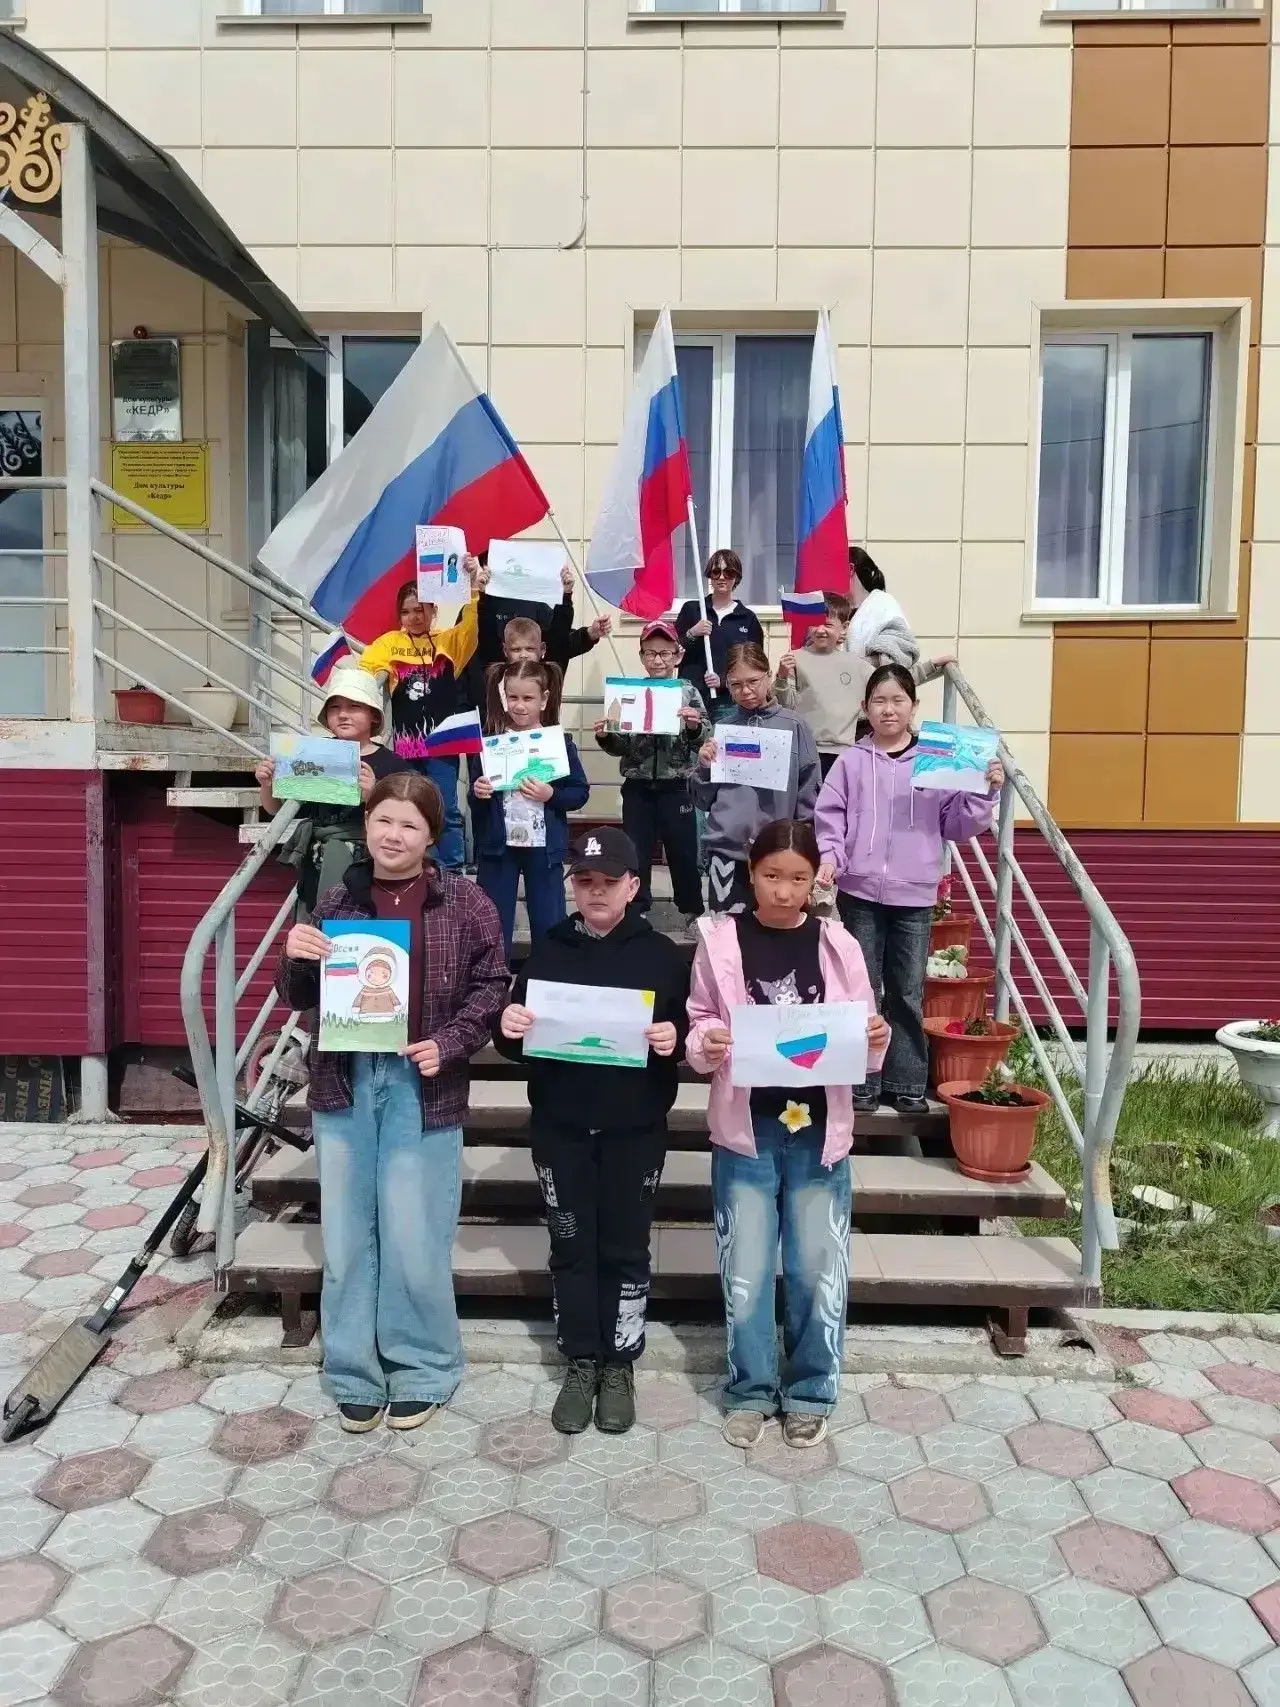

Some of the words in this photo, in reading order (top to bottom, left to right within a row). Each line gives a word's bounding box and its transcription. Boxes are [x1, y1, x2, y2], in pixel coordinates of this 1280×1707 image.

[126, 405, 170, 416] «КЕДР»
[133, 481, 149, 489] Дом
[150, 483, 185, 491] культуры
[147, 492, 172, 500] «Кедр»
[390, 646, 432, 657] DREAM
[584, 837, 602, 856] LA
